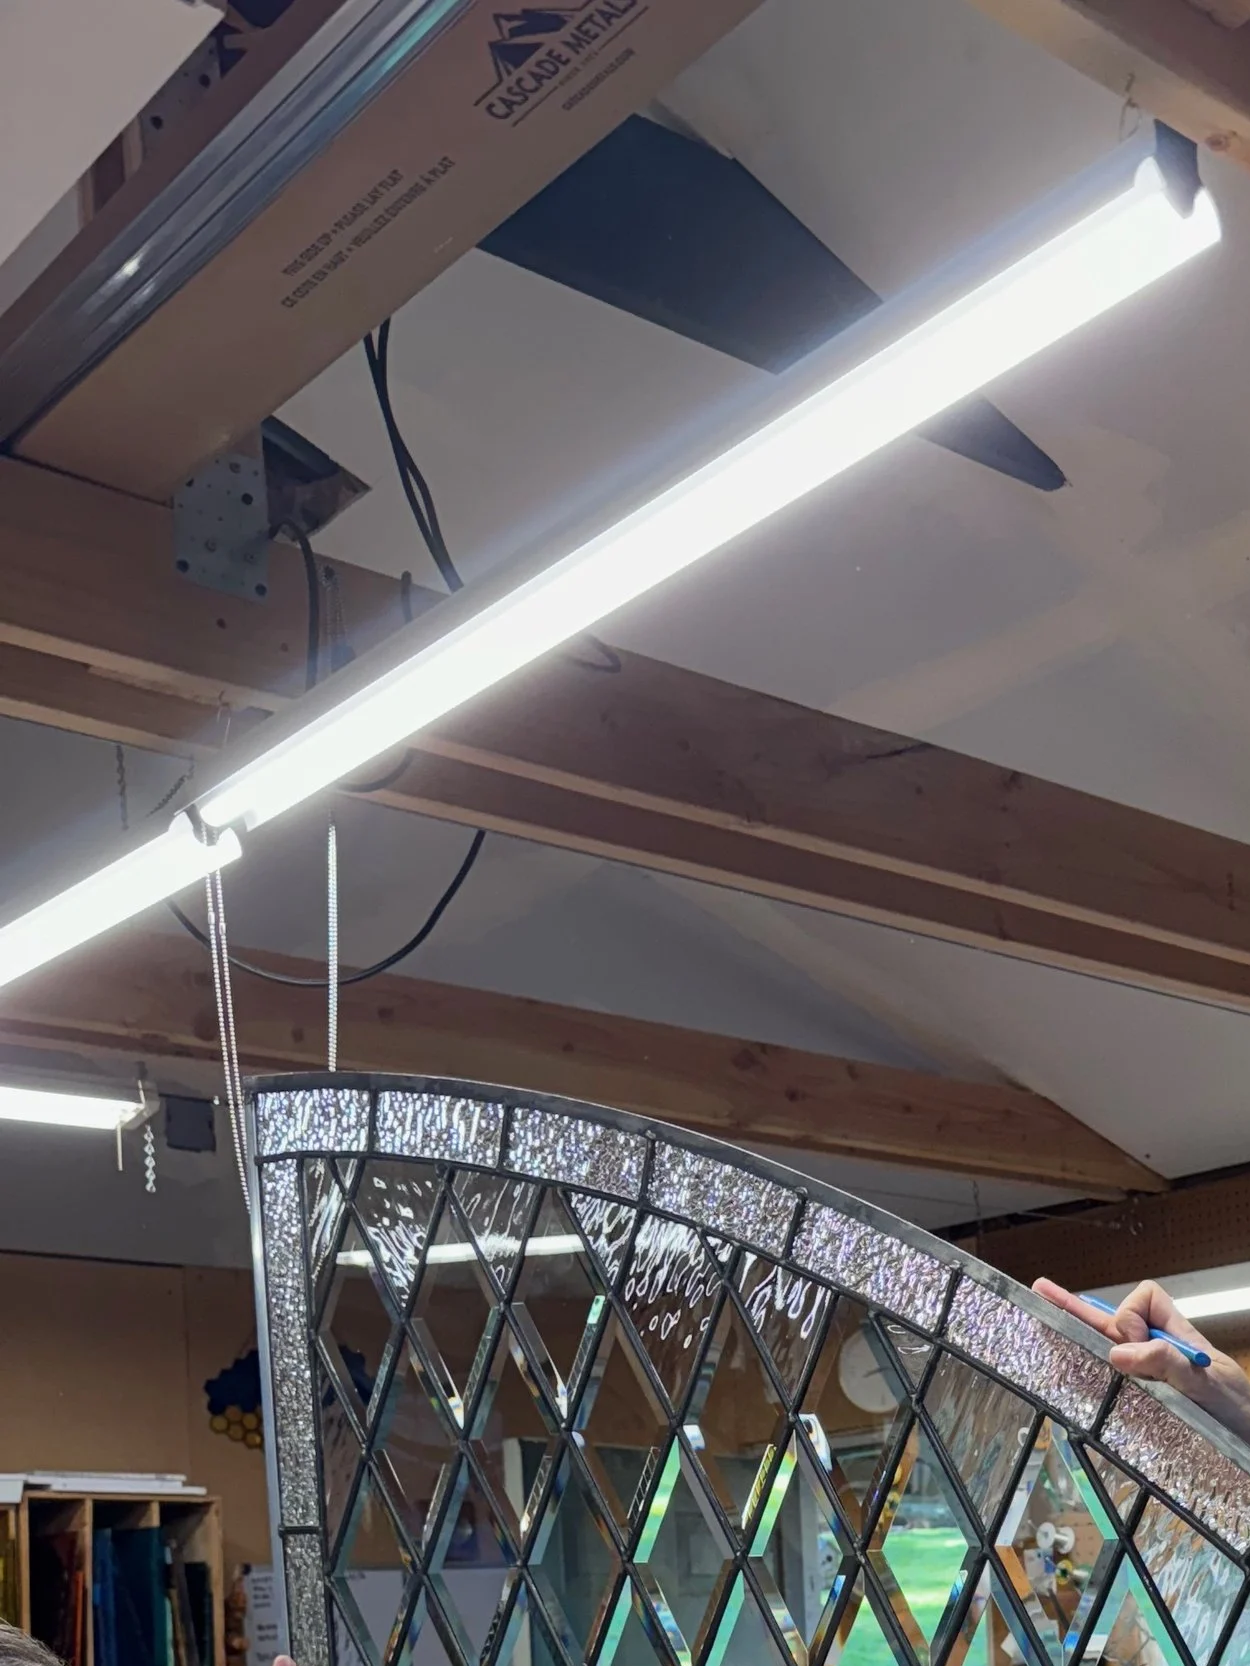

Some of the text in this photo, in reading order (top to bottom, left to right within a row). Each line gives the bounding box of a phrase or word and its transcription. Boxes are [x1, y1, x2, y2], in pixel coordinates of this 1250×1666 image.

[485, 49, 571, 119] CASCADE
[561, 0, 638, 54] METAL
[363, 187, 384, 205] LAY
[378, 169, 404, 191] FLAT
